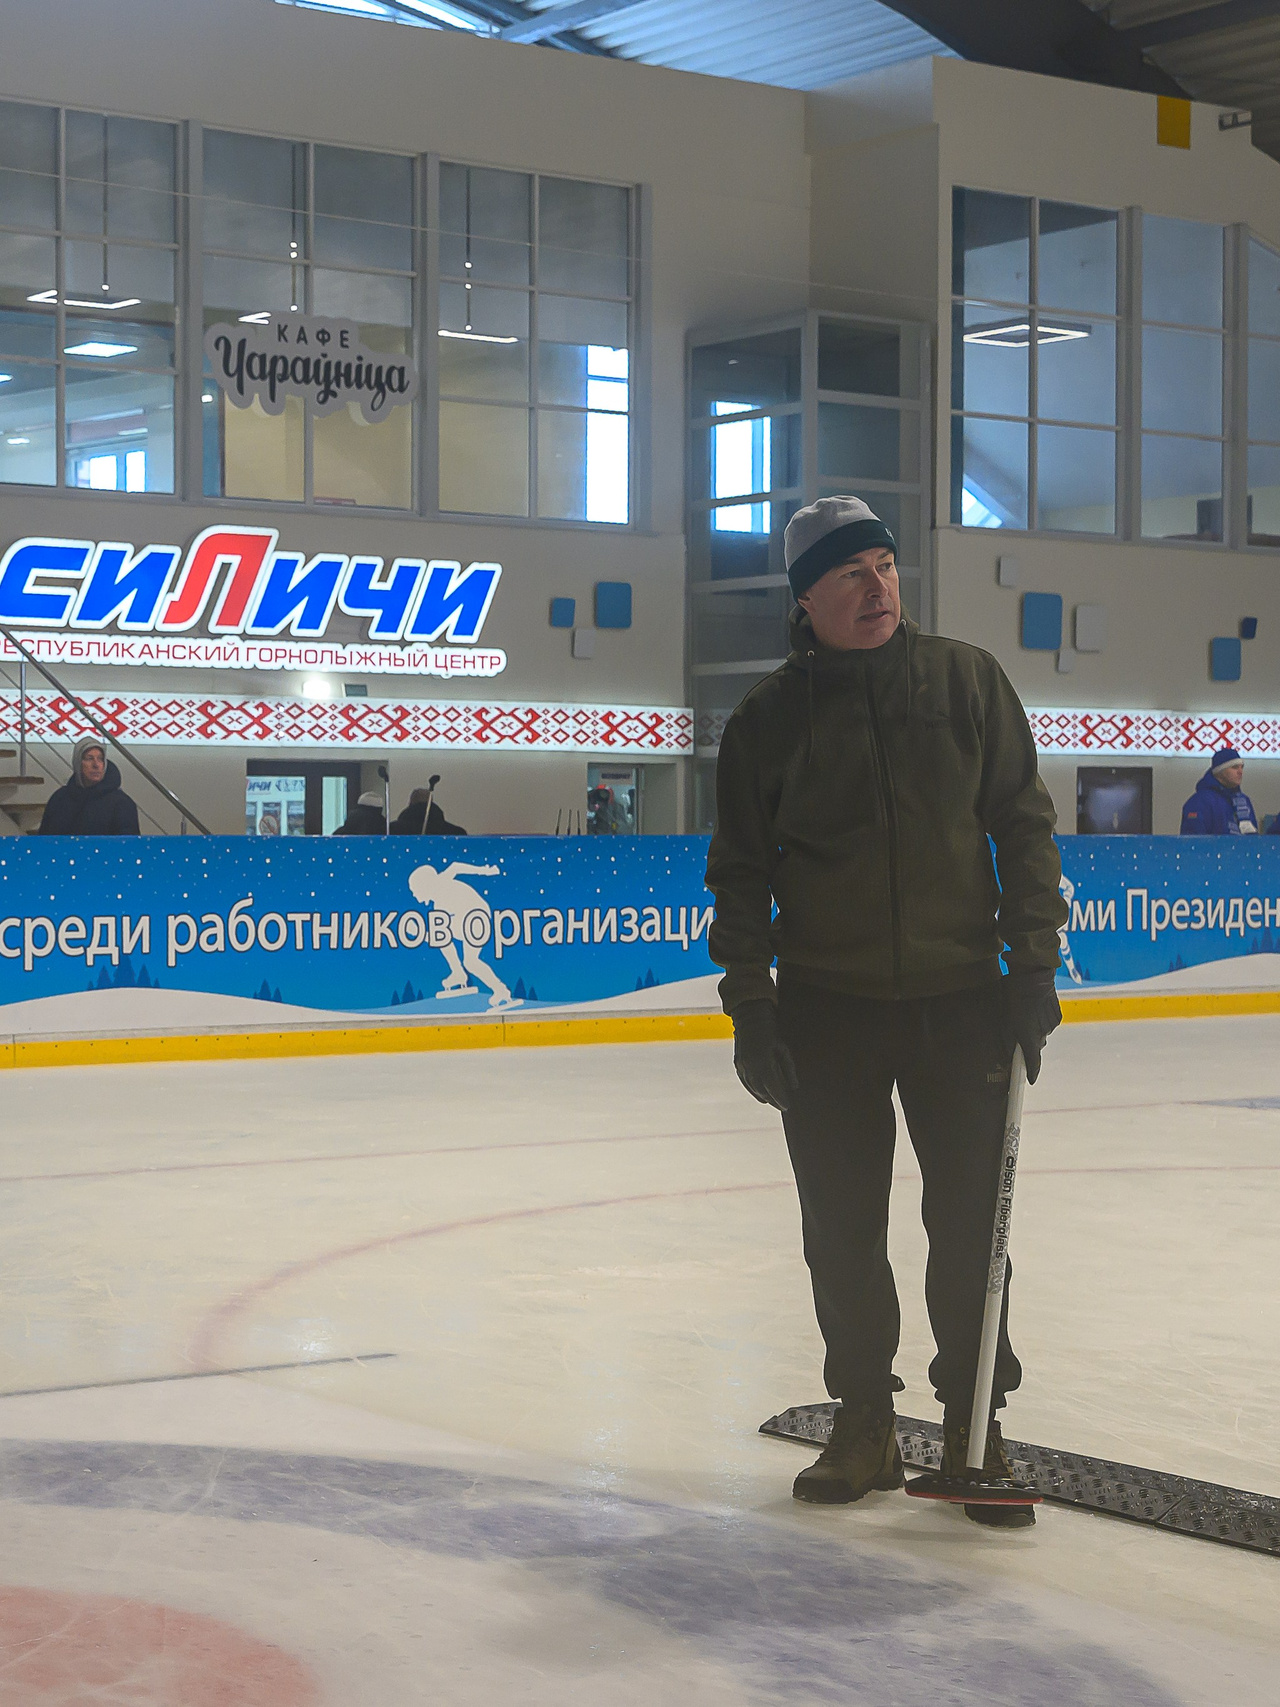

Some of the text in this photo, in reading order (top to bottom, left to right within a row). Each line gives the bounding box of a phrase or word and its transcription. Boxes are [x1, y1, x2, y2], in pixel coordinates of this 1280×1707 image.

[276, 323, 350, 349] КАФЕ
[214, 335, 410, 412] Чараўніца
[244, 642, 429, 668] ГОРНОЛЫЖНЫЙ
[433, 652, 503, 672] ЦЕНТР
[246, 779, 272, 792] ИЧИ
[166, 897, 453, 967] работников
[1057, 899, 1117, 932] ми
[1125, 887, 1280, 942] Президен
[994, 1155, 1016, 1259] Olson Fiberglass
